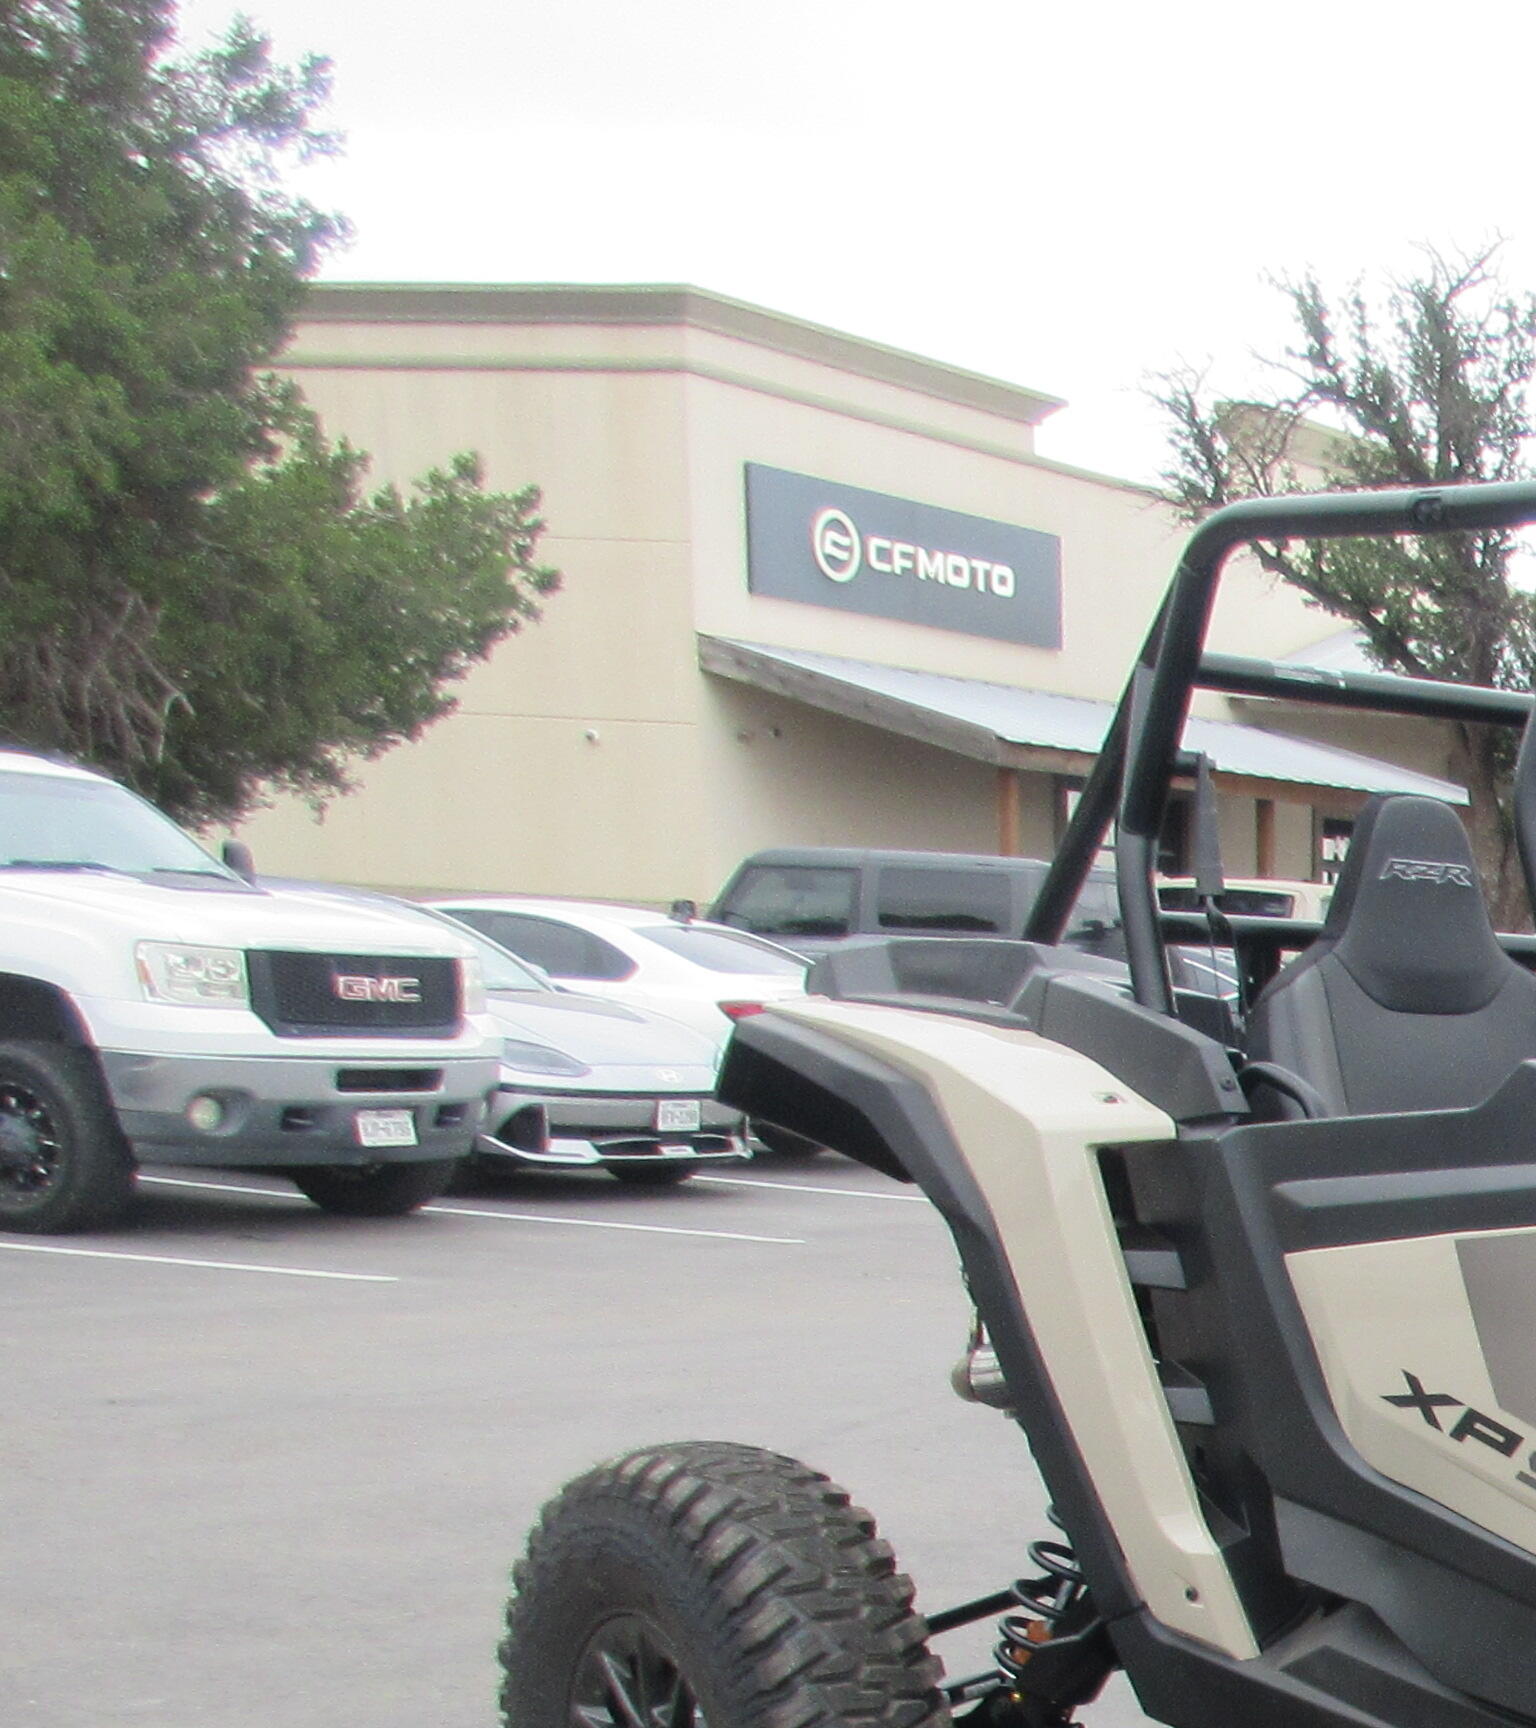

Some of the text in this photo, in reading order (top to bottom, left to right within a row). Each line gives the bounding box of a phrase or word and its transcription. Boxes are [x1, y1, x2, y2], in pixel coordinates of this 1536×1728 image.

[867, 535, 1015, 598] CFMOTO
[1377, 857, 1472, 888] RZR
[337, 975, 421, 1002] GMC
